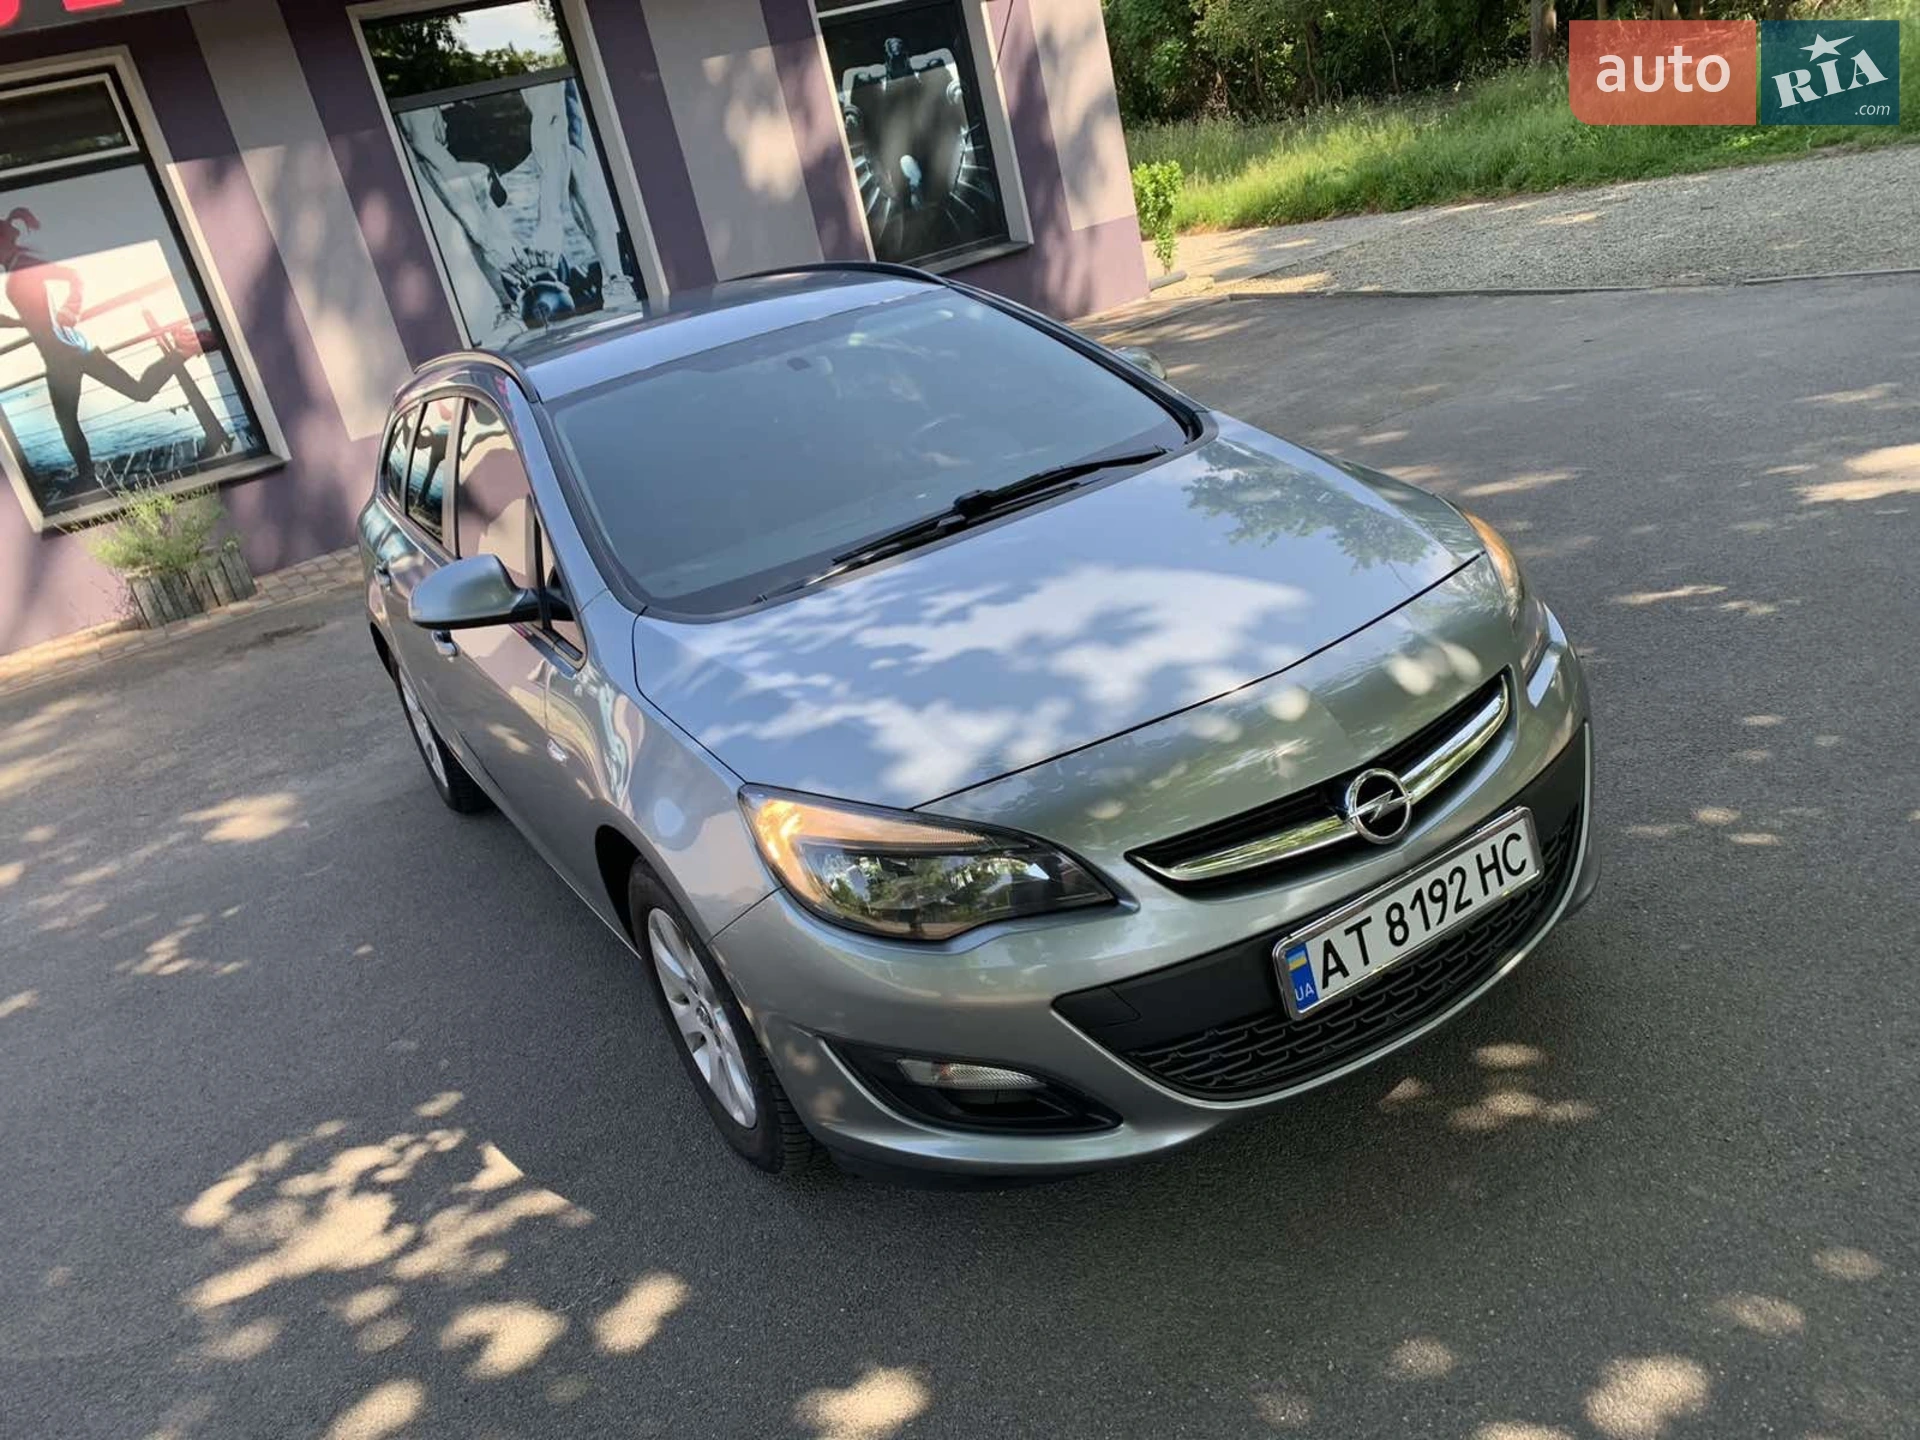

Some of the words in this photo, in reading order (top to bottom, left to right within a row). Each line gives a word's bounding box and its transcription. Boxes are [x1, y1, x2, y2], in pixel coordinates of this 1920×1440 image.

[1321, 916, 1373, 990] AT
[1385, 866, 1473, 948] 8192
[1475, 832, 1528, 897] HC
[1294, 983, 1315, 1001] UA
